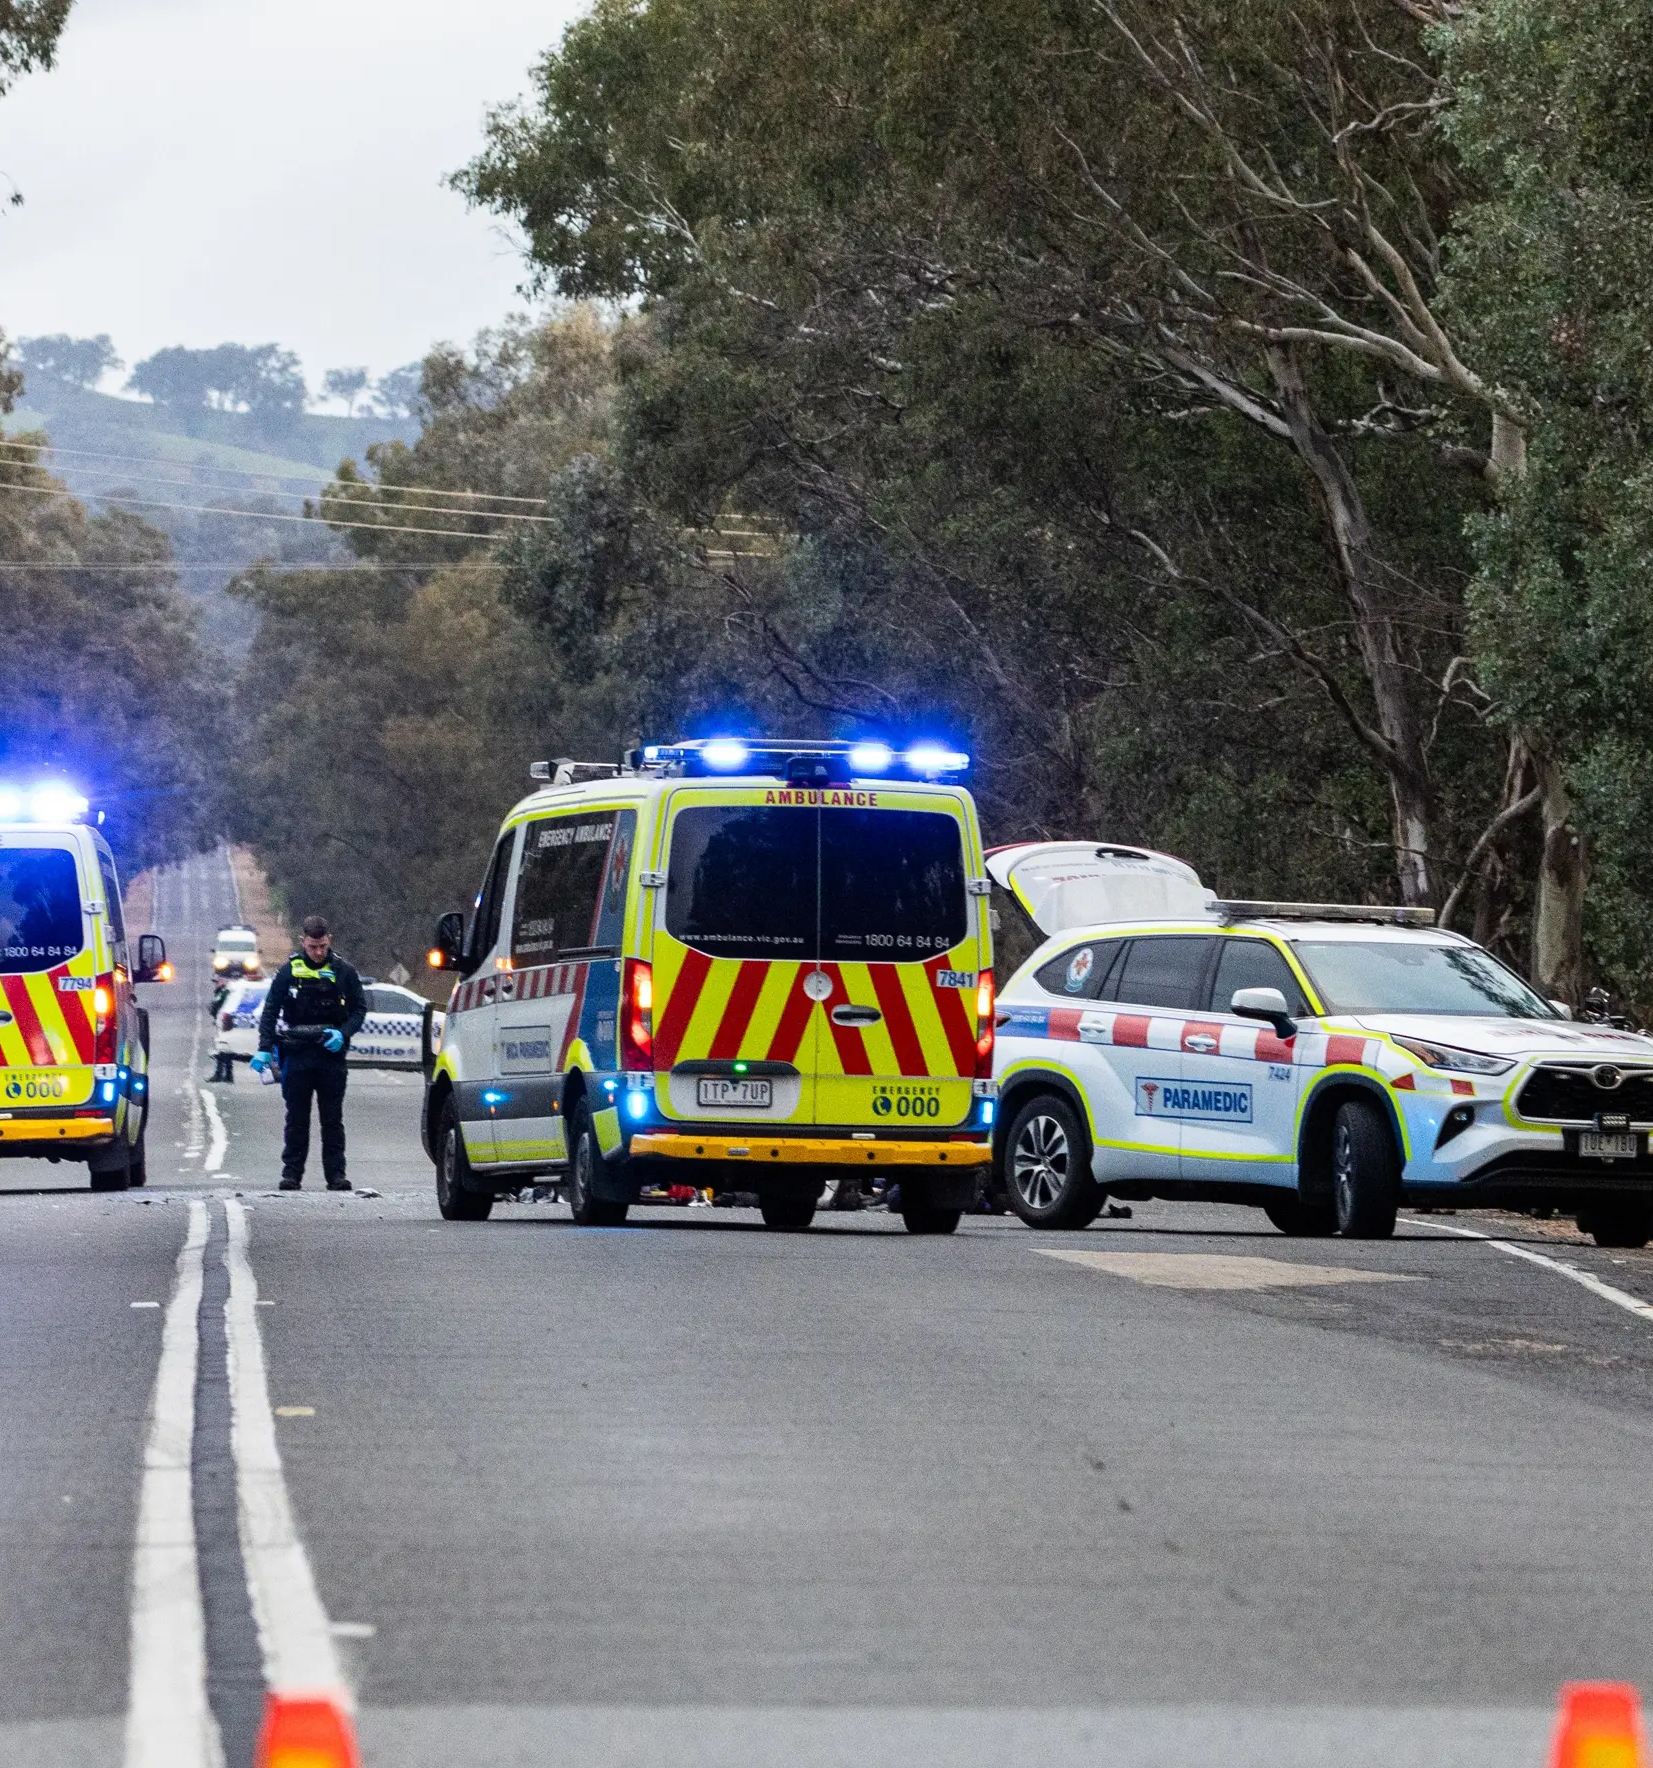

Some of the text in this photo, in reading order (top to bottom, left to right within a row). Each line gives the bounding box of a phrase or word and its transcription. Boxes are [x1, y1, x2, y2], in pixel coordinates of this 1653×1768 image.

[765, 790, 878, 807] AMBULANCE
[678, 933, 805, 945] www.ambulance.vic.gov.au
[865, 933, 950, 949] 1800 64 84 84
[3, 946, 29, 958] 1800
[30, 946, 45, 957] 64
[47, 945, 61, 957] 84
[63, 945, 77, 957] 84
[59, 977, 93, 990] 7794
[939, 971, 974, 988] 7841
[26, 1081, 63, 1099] 000
[703, 1083, 768, 1100] 1TP 7UP
[872, 1085, 941, 1096] EMERGENCY
[896, 1096, 941, 1118] 000
[1162, 1087, 1249, 1114] PARAMEDIC
